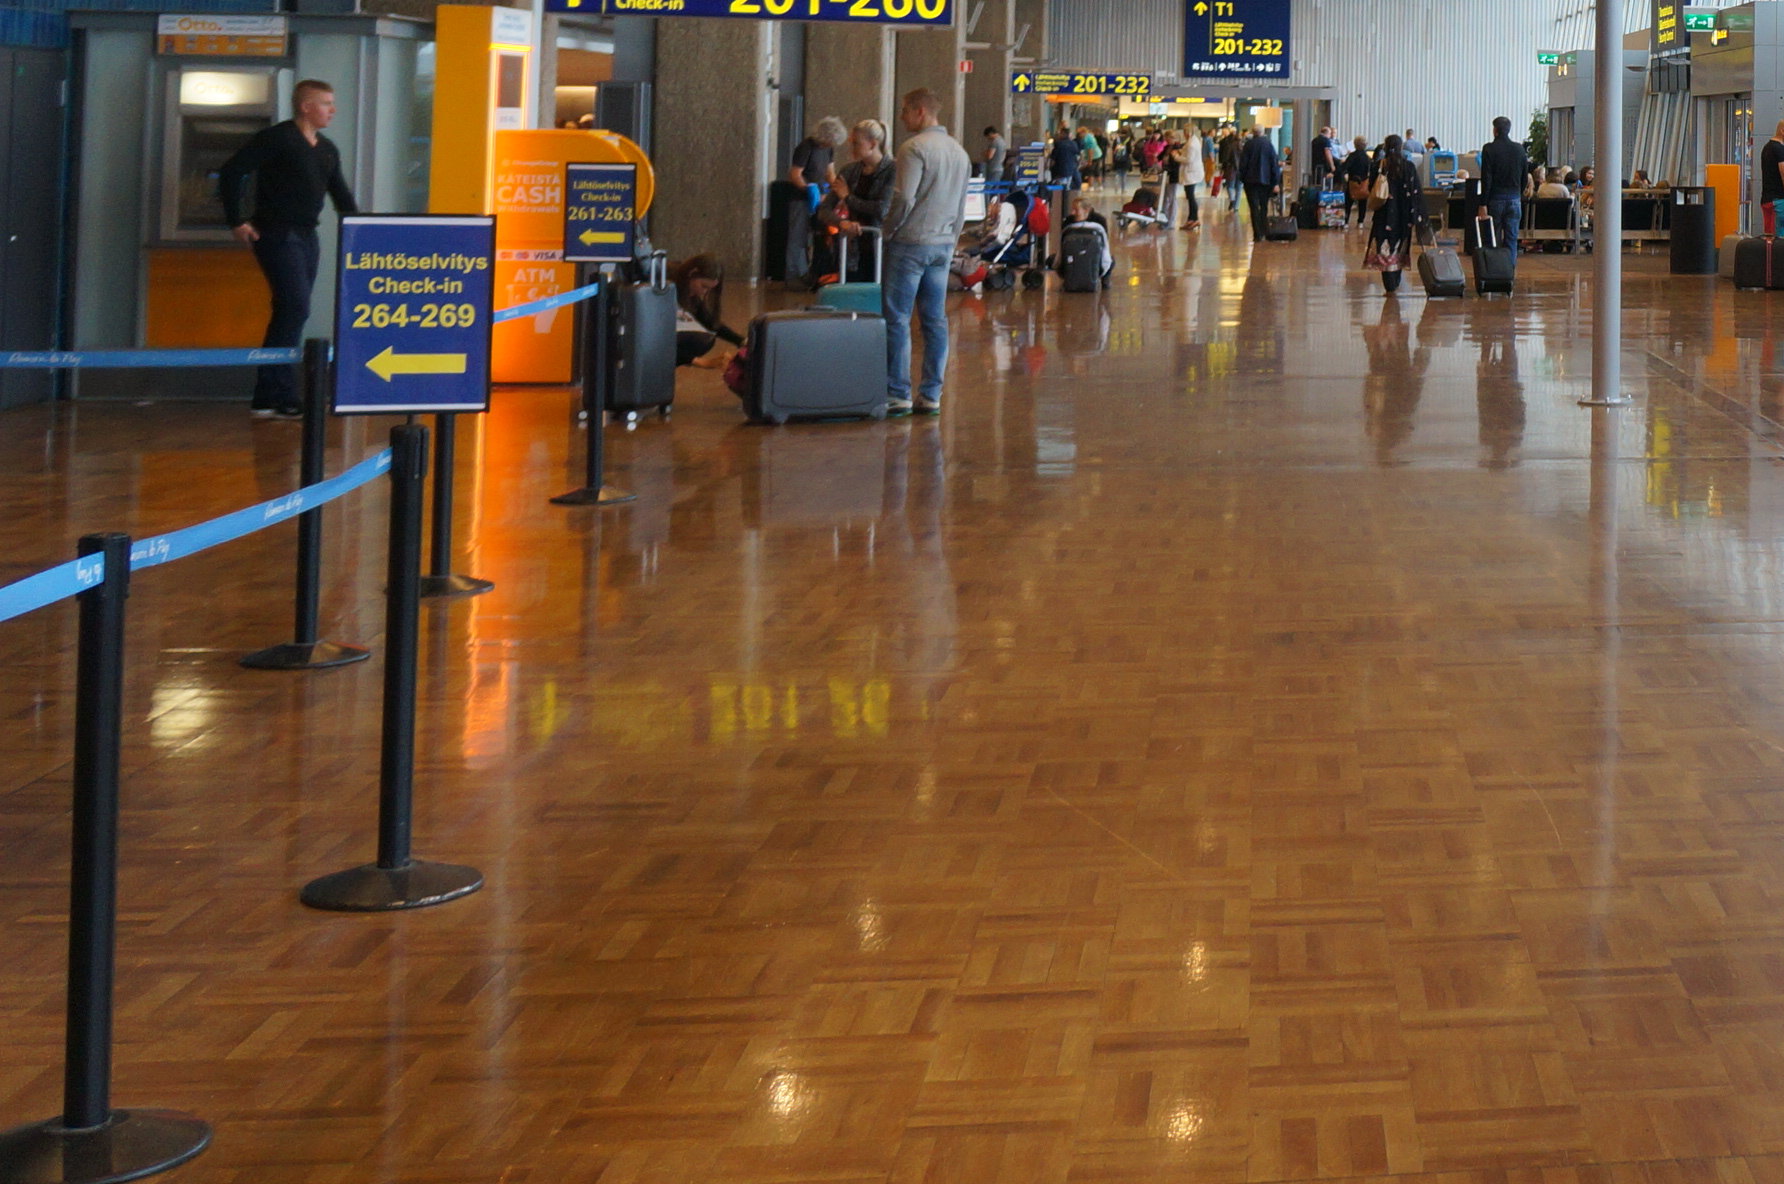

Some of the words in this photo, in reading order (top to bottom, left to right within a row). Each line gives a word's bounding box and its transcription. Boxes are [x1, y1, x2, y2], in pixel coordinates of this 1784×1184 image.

[1215, 1, 1234, 17] T1
[1213, 38, 1283, 56] 201-232
[1073, 74, 1150, 95] 201-232
[573, 180, 630, 192] Lähtöselvitys
[497, 186, 561, 204] CASH
[581, 192, 622, 203] Check-in
[568, 206, 634, 221] 261-263
[346, 253, 488, 274] Lähtöselvitys
[534, 251, 556, 261] VISA
[514, 268, 556, 283] ATM
[368, 276, 463, 294] Check-in
[352, 303, 476, 328] 264-269
